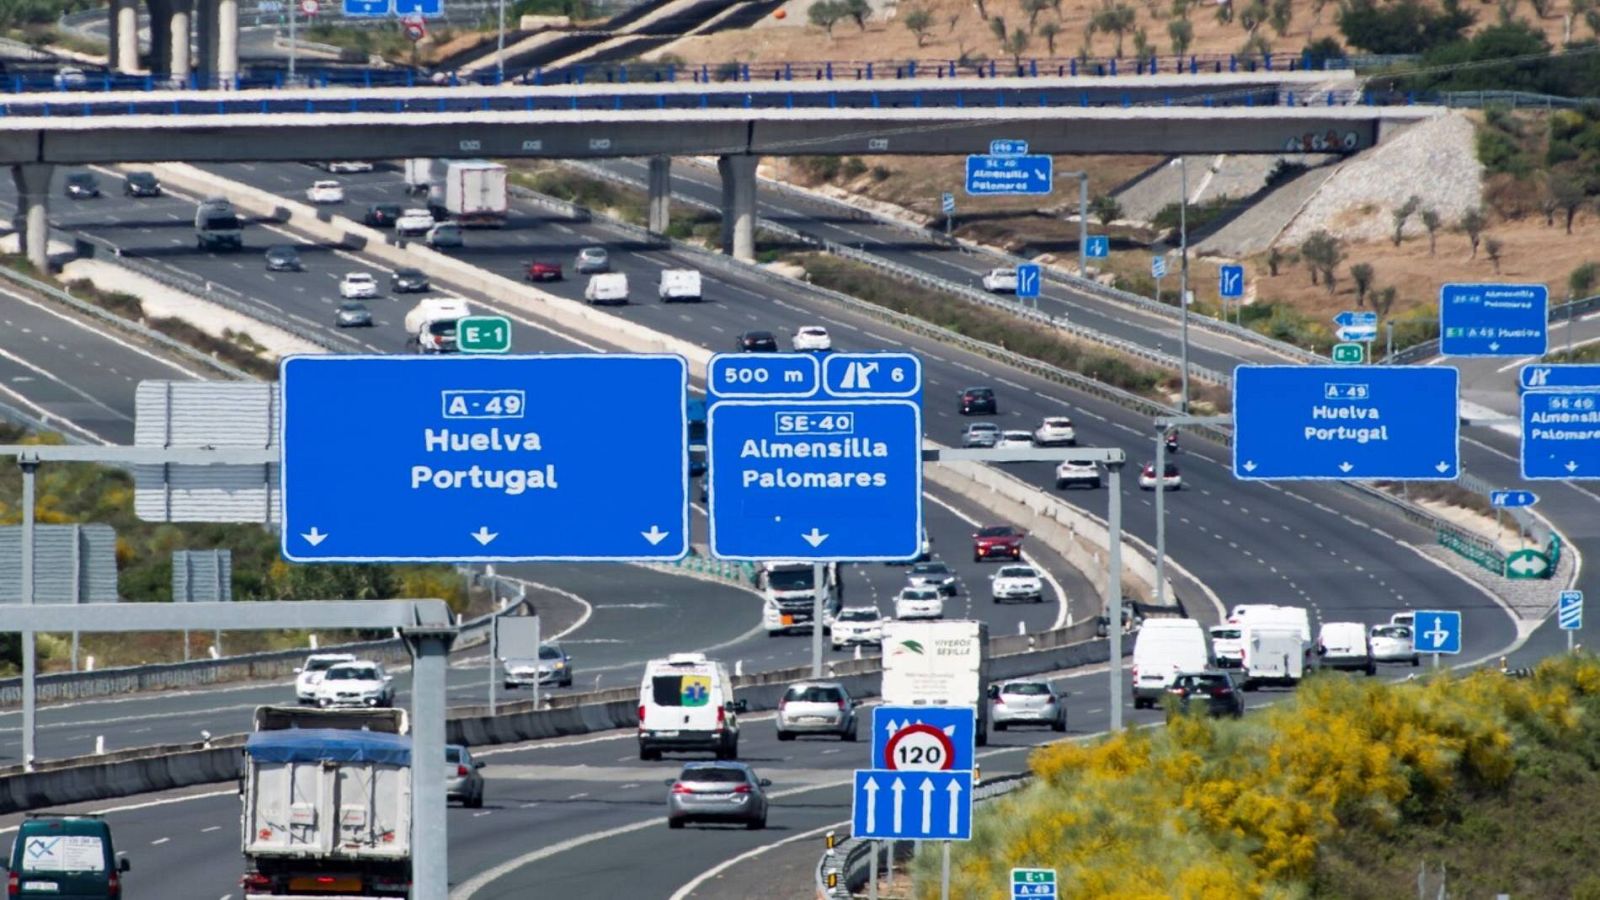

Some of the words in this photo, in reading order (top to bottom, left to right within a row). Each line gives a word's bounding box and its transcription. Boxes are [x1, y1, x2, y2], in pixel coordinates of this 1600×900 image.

[466, 327, 503, 342] E-1
[725, 368, 769, 383] 500
[784, 370, 803, 382] m
[891, 367, 904, 382] 6
[1328, 386, 1366, 397] A-49
[449, 395, 521, 415] A-49
[1312, 405, 1379, 419] Huelva
[779, 415, 849, 431] SE-40
[425, 427, 542, 452] Huelva
[1304, 425, 1388, 443] Portugal
[740, 438, 888, 458] Almensilla
[411, 464, 558, 495] Portugal
[742, 468, 887, 487] Palomares
[899, 746, 941, 764] 120
[1026, 873, 1045, 881] E-1
[1020, 885, 1050, 894] A-49
